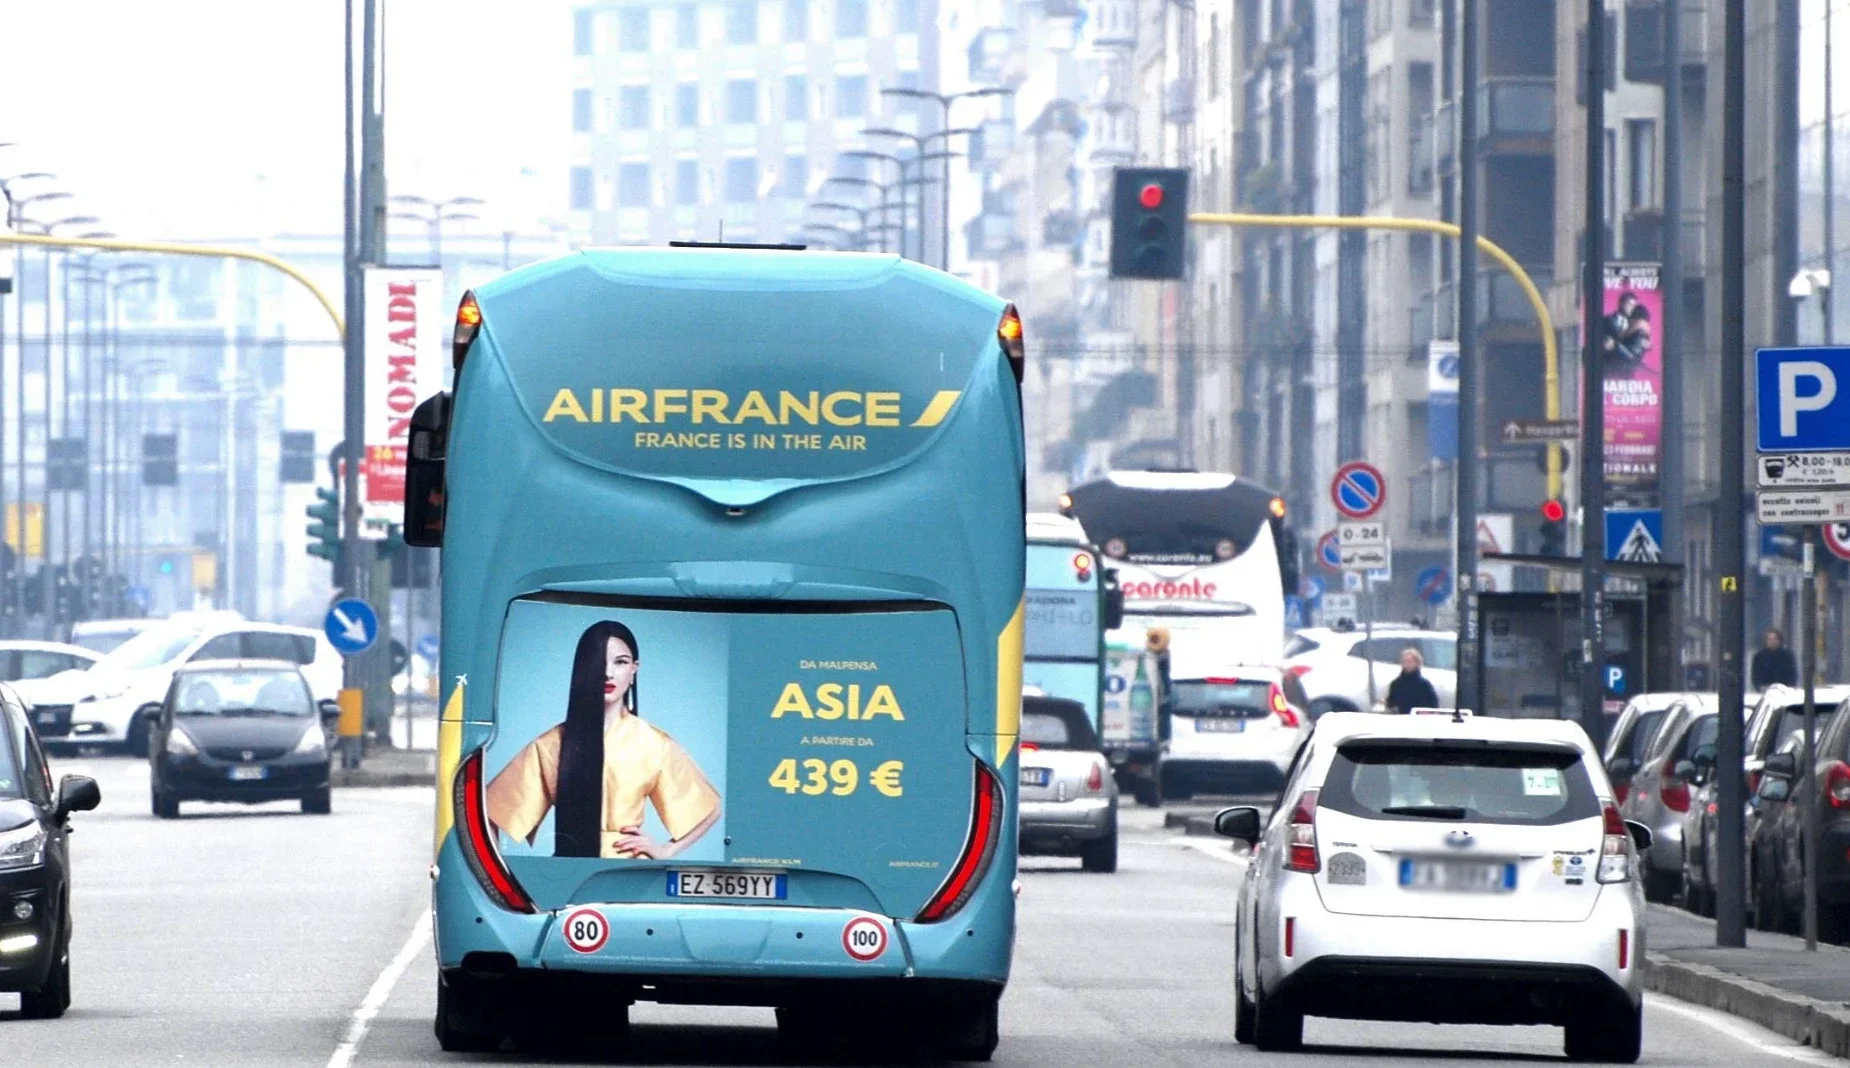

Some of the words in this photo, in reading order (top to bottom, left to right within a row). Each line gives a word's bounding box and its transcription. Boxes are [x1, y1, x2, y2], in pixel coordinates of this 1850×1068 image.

[388, 282, 417, 440] NOMADI
[543, 388, 901, 426] AIRFRANCE
[1778, 360, 1837, 437] P
[634, 432, 721, 448] FRANCE
[728, 433, 746, 448] IS
[754, 433, 776, 449] IN
[781, 433, 821, 449] THE
[828, 434, 867, 450] AIR
[800, 660, 817, 669] DA
[819, 661, 878, 671] MALPENSA
[1609, 667, 1622, 688] P
[770, 683, 905, 720] ASIA
[801, 736, 810, 744] A
[812, 736, 856, 746] PARTIRE
[858, 737, 874, 746] DA
[768, 758, 859, 796] 439
[869, 760, 904, 797] €
[681, 874, 705, 894] EZ
[712, 874, 773, 896] 569YY
[574, 920, 598, 941] 80
[852, 930, 878, 946] 100
